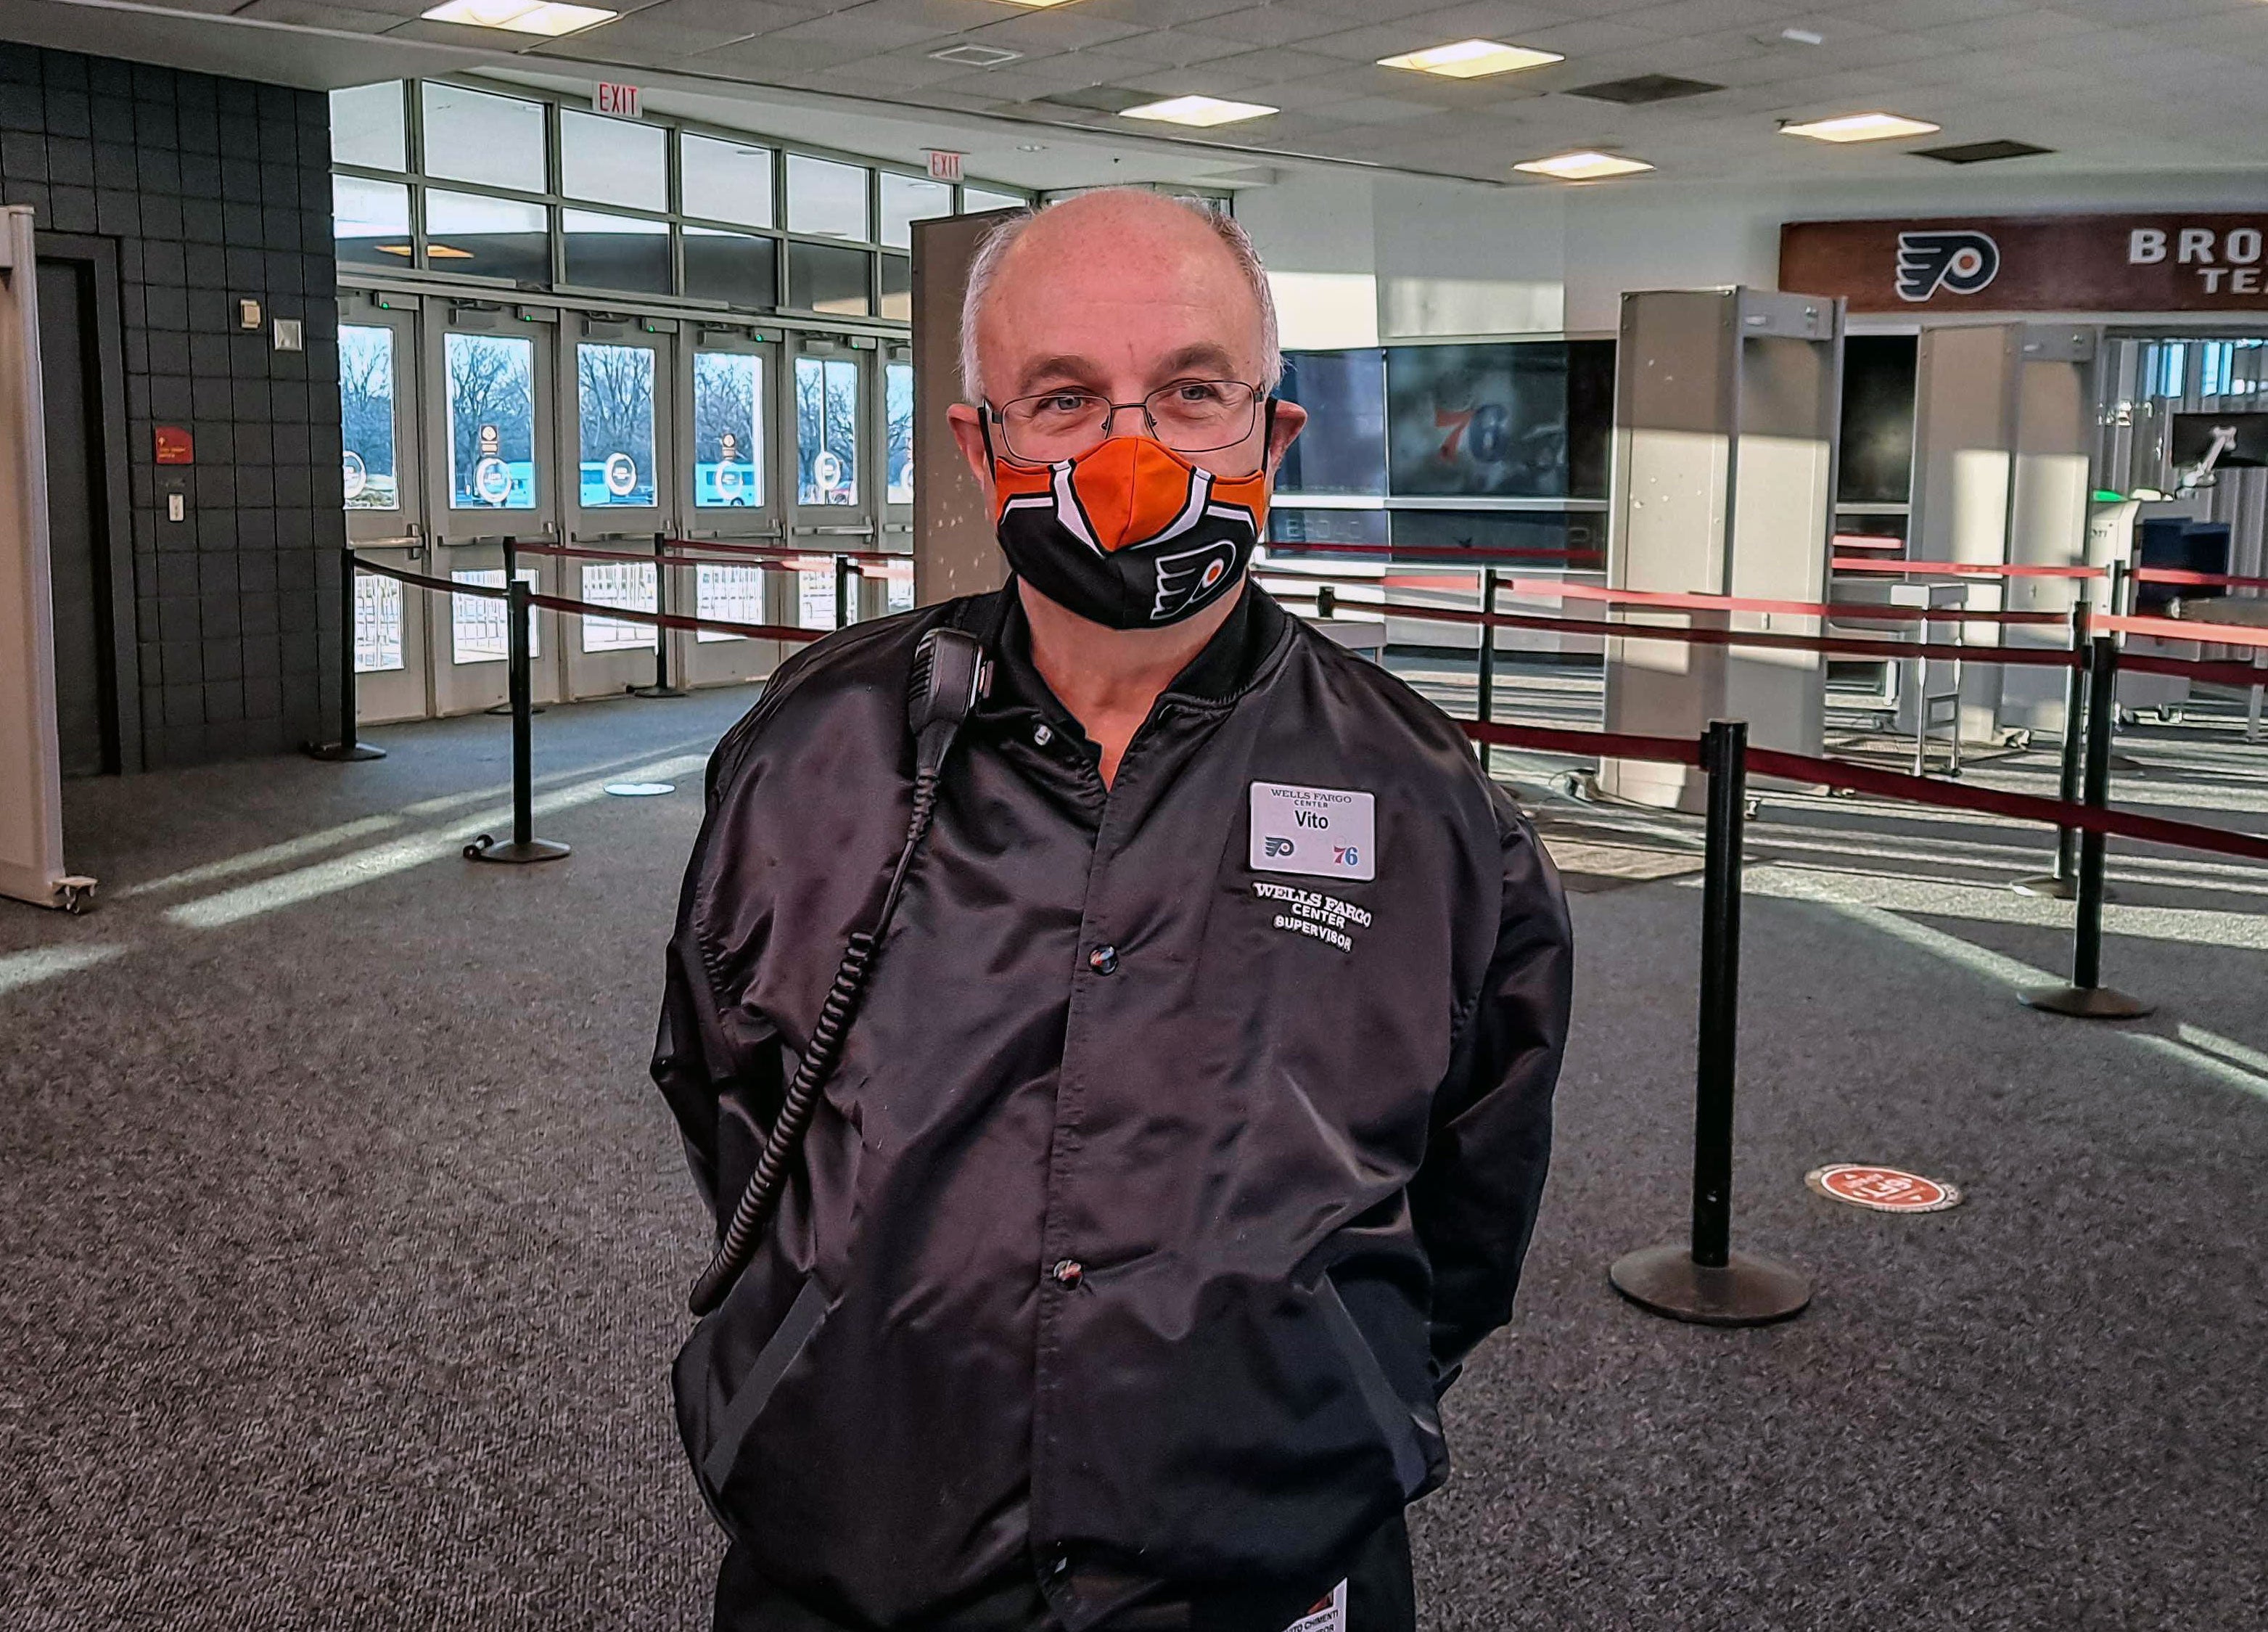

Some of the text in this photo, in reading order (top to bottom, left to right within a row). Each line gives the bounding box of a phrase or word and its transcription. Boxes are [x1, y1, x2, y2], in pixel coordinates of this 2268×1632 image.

[599, 83, 637, 115] EXIT
[932, 153, 959, 179] EXIT
[2129, 228, 2263, 264] BRO
[2197, 268, 2268, 295] TE
[1434, 404, 1511, 463] 76
[1270, 789, 1352, 804] WELLS FARGO
[1294, 800, 1328, 808] CENTER
[1294, 810, 1328, 829] Vito
[1334, 846, 1358, 866] 76
[1252, 882, 1372, 927] WELLS FARGO
[1291, 903, 1346, 929] CENTER
[1274, 915, 1352, 952] SUPERVISOR
